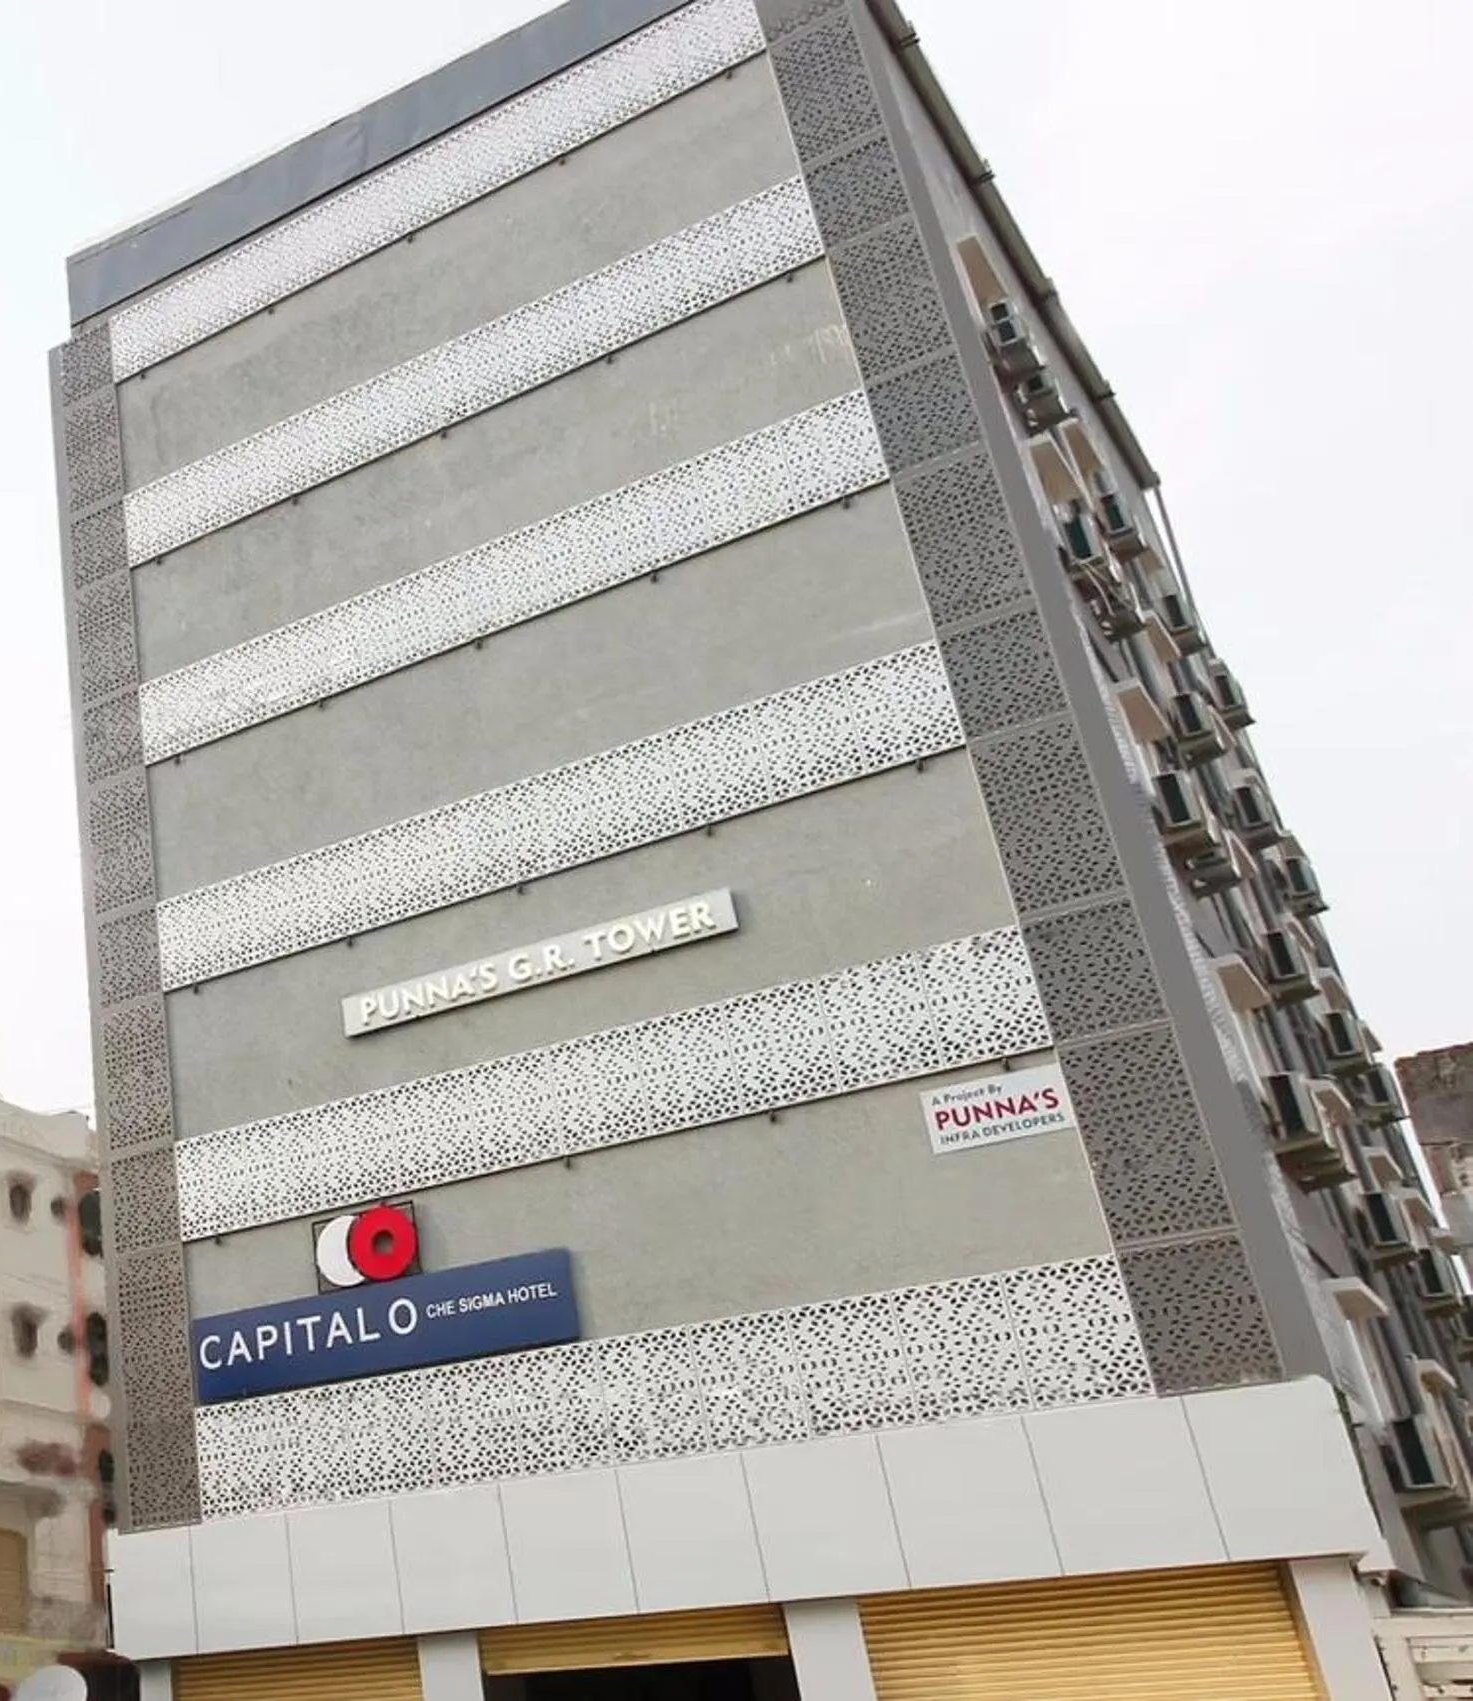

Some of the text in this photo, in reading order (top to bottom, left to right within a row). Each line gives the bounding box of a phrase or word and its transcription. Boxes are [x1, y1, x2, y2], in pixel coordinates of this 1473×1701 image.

[360, 901, 717, 1027] PUNNA'S G.R. TOWER
[932, 1097, 940, 1106] A
[944, 1087, 984, 1105] Project
[935, 1087, 1059, 1131] PUNNA'S
[941, 1112, 1065, 1145] INFRA DEVELOPERS
[426, 1282, 559, 1320] CHE SIGMA HOTEL
